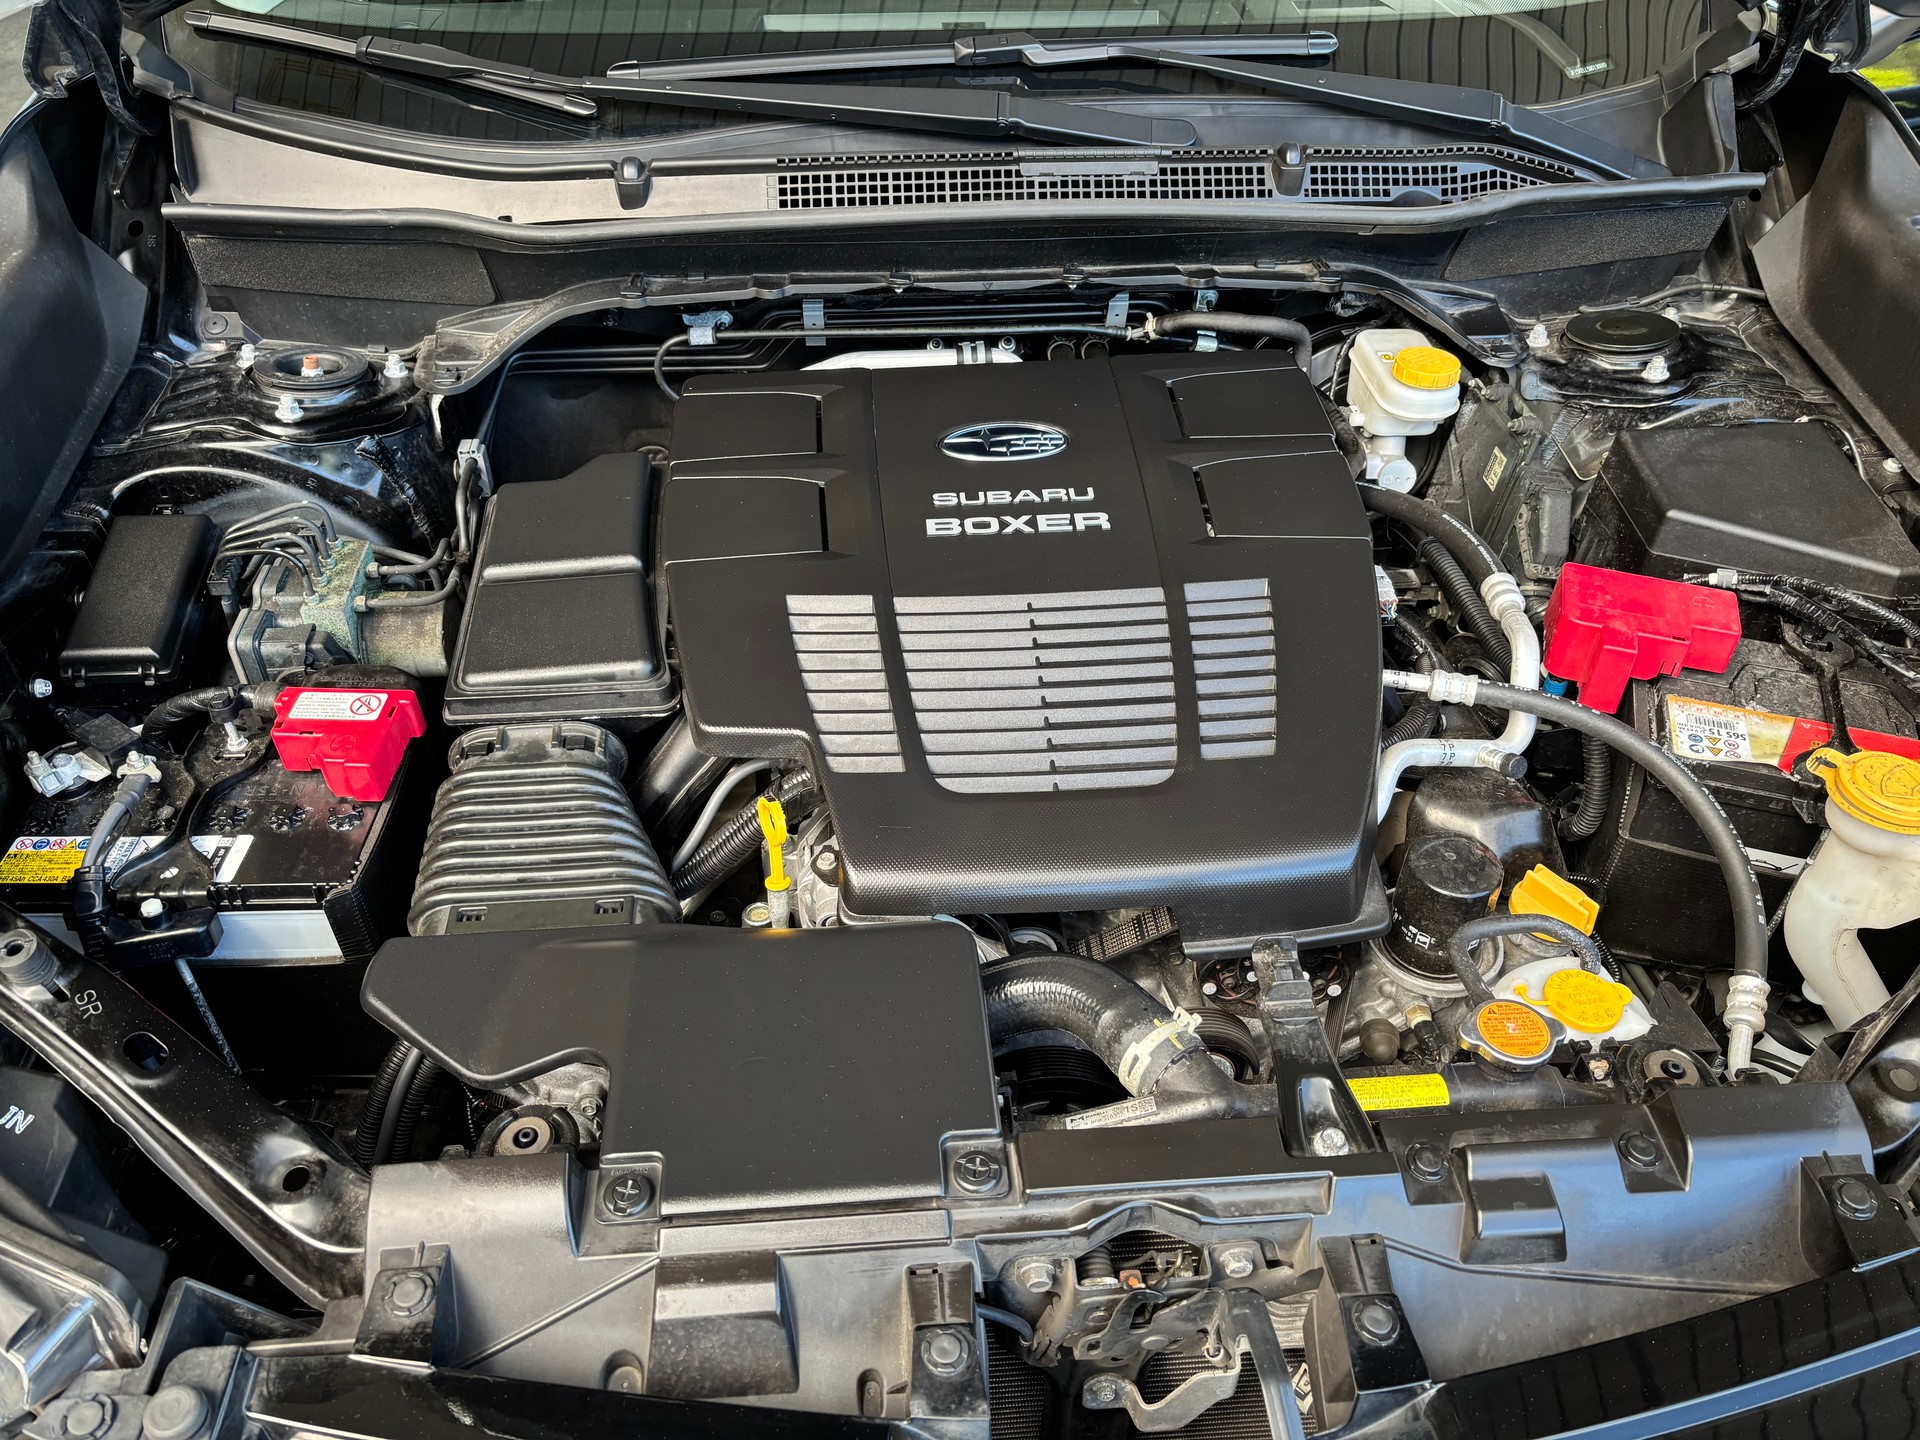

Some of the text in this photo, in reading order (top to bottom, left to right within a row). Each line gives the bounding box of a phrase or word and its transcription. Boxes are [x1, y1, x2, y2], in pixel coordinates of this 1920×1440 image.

[932, 486, 1095, 507] SUBARU
[925, 511, 1111, 537] BOXER
[1708, 727, 1747, 741] 565 15
[1661, 747, 1700, 783] YOKOHAMA
[75, 989, 103, 1019] SR
